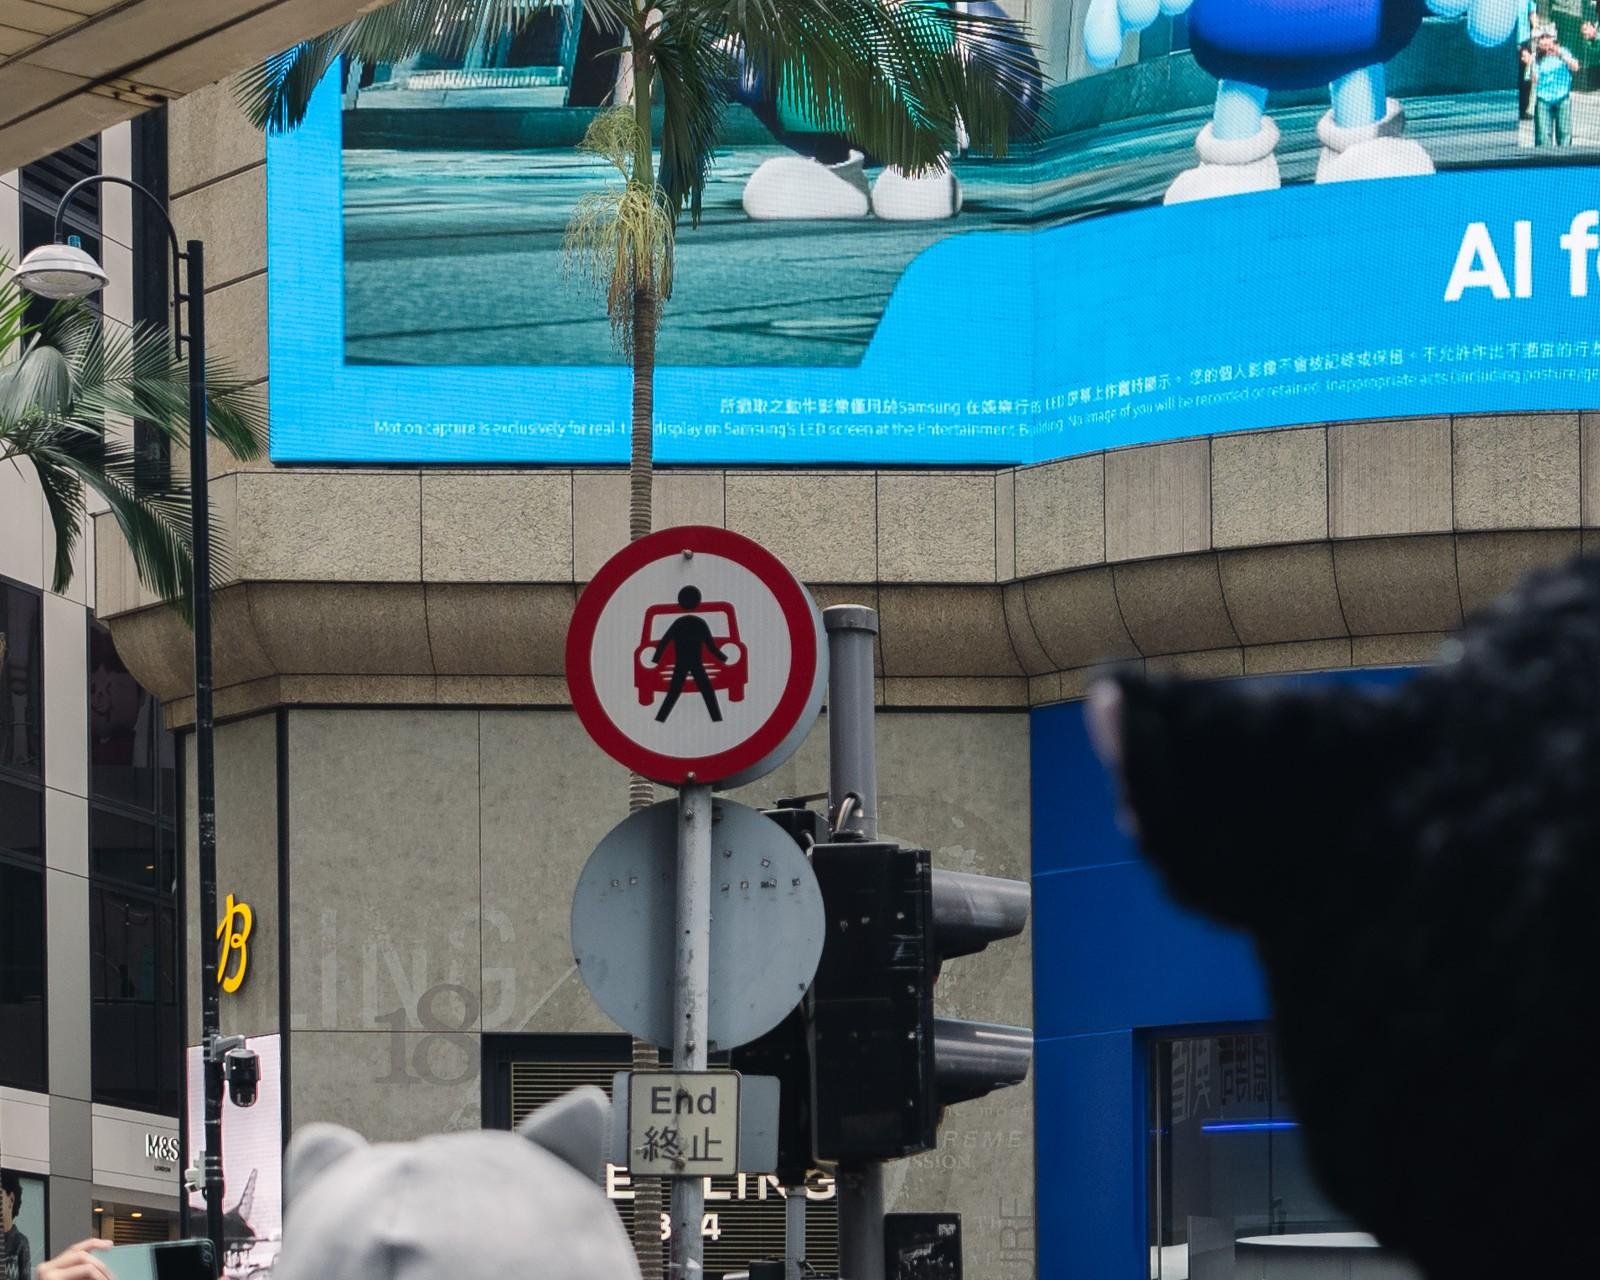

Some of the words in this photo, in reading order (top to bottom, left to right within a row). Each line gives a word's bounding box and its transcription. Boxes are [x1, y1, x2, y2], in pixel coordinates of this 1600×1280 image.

[650, 1085, 717, 1115] End
[145, 1133, 180, 1162] M&S
[640, 1125, 724, 1164] 終止
